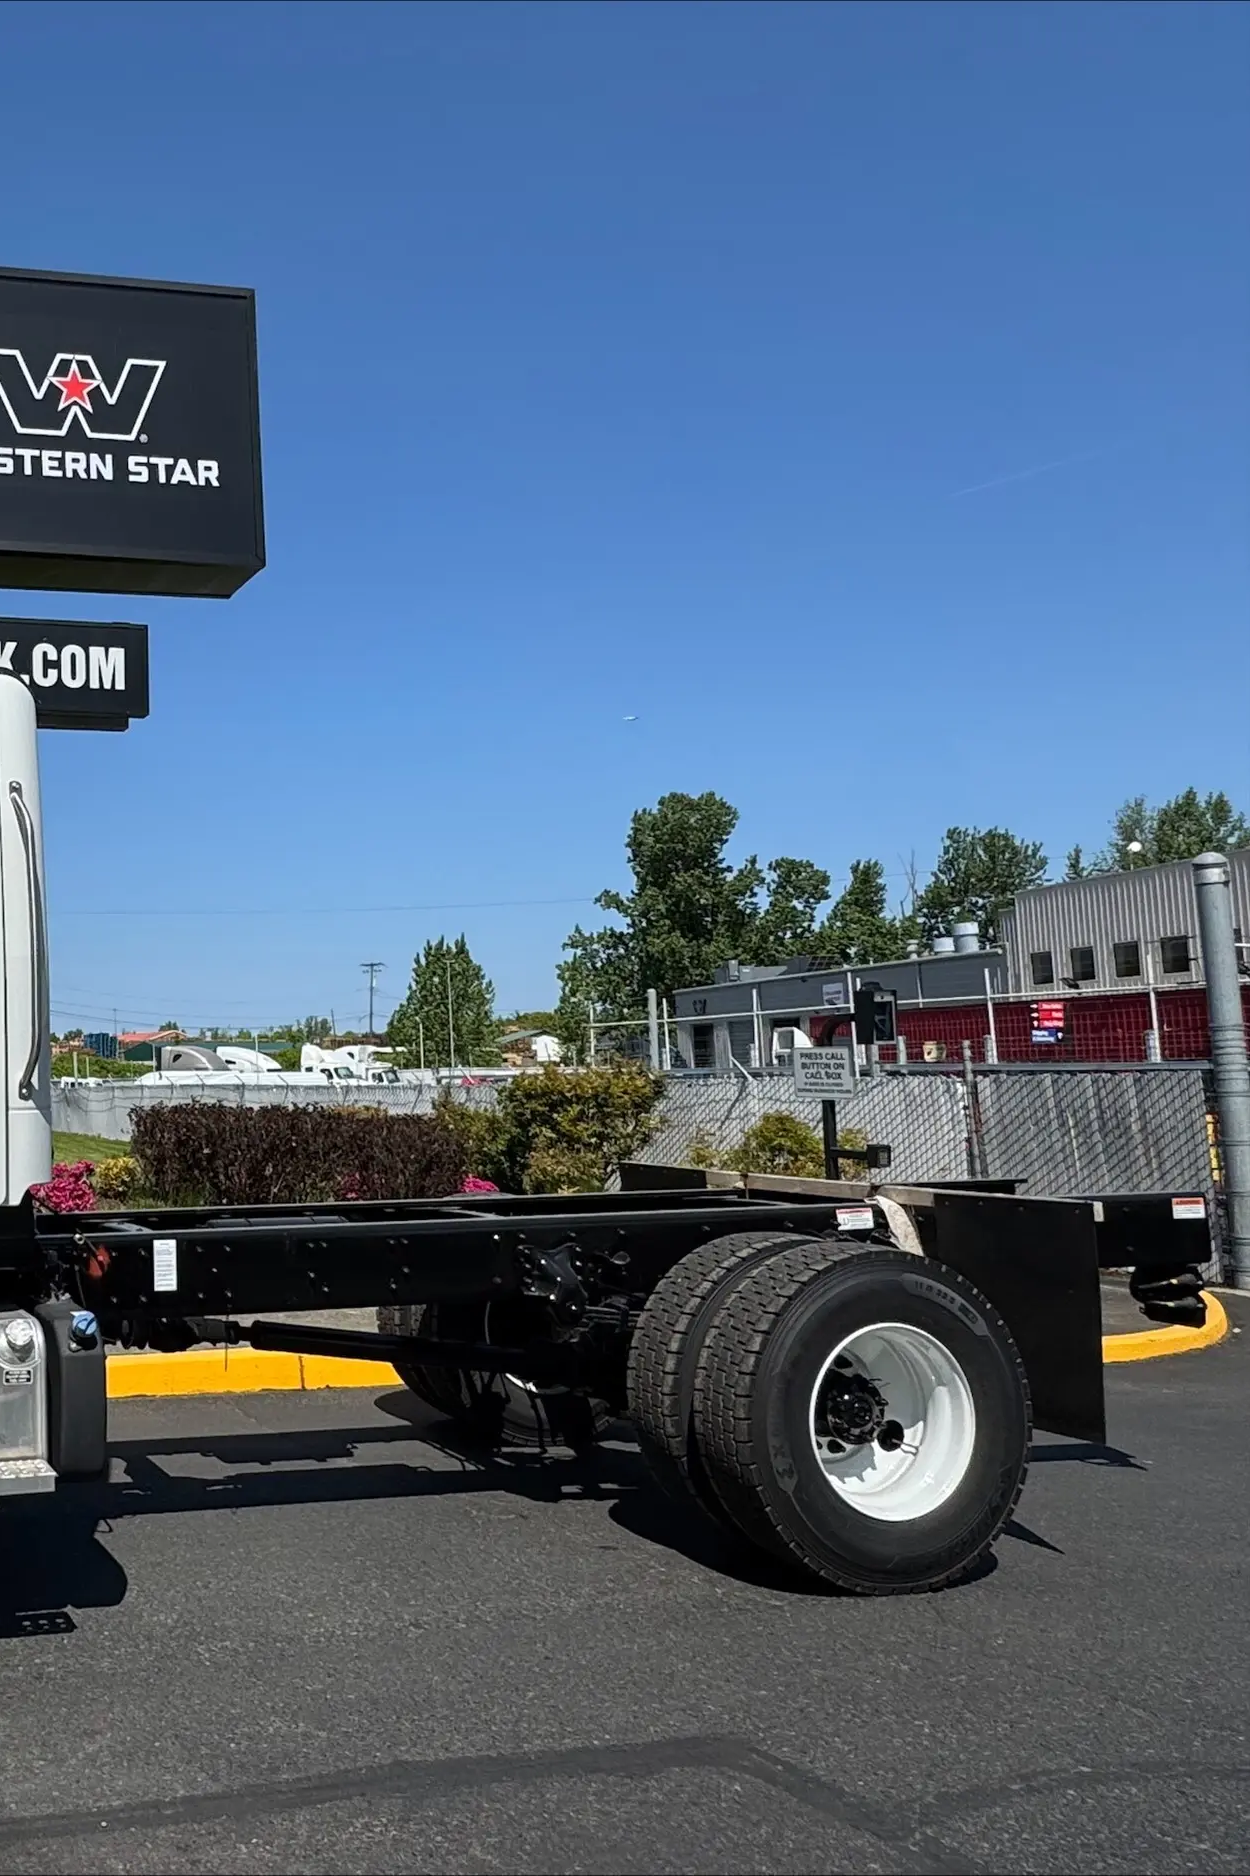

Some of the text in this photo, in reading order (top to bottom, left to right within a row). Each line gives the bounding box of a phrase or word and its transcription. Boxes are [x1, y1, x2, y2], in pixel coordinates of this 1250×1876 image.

[127, 455, 220, 487] STAR
[799, 1052, 845, 1061] PRESS CALL
[801, 1062, 845, 1070] BUTTON ON
[805, 1071, 842, 1080] CALL BOX
